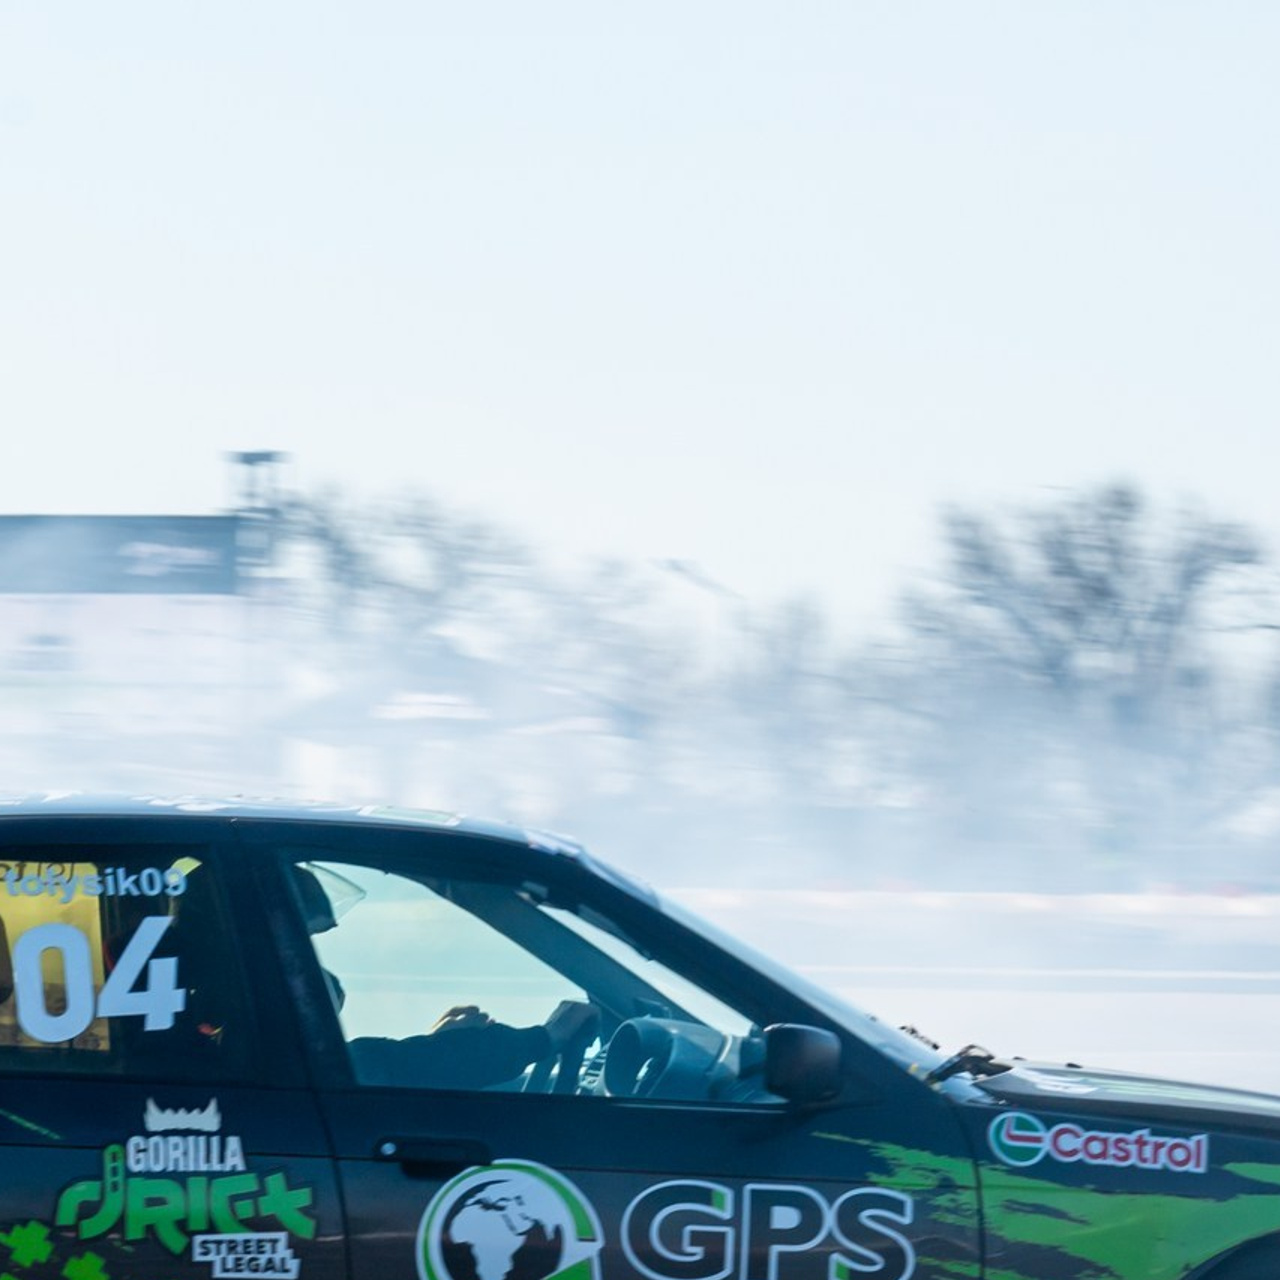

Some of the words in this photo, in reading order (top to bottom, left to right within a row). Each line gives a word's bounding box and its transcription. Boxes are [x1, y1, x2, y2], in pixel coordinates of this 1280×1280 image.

[4, 866, 187, 903] tolysik09
[13, 915, 186, 1044] 04
[126, 1135, 247, 1172] GORILLA
[1050, 1124, 1205, 1172] Castrol
[199, 1238, 281, 1255] STREET
[222, 1256, 291, 1274] LEGAL
